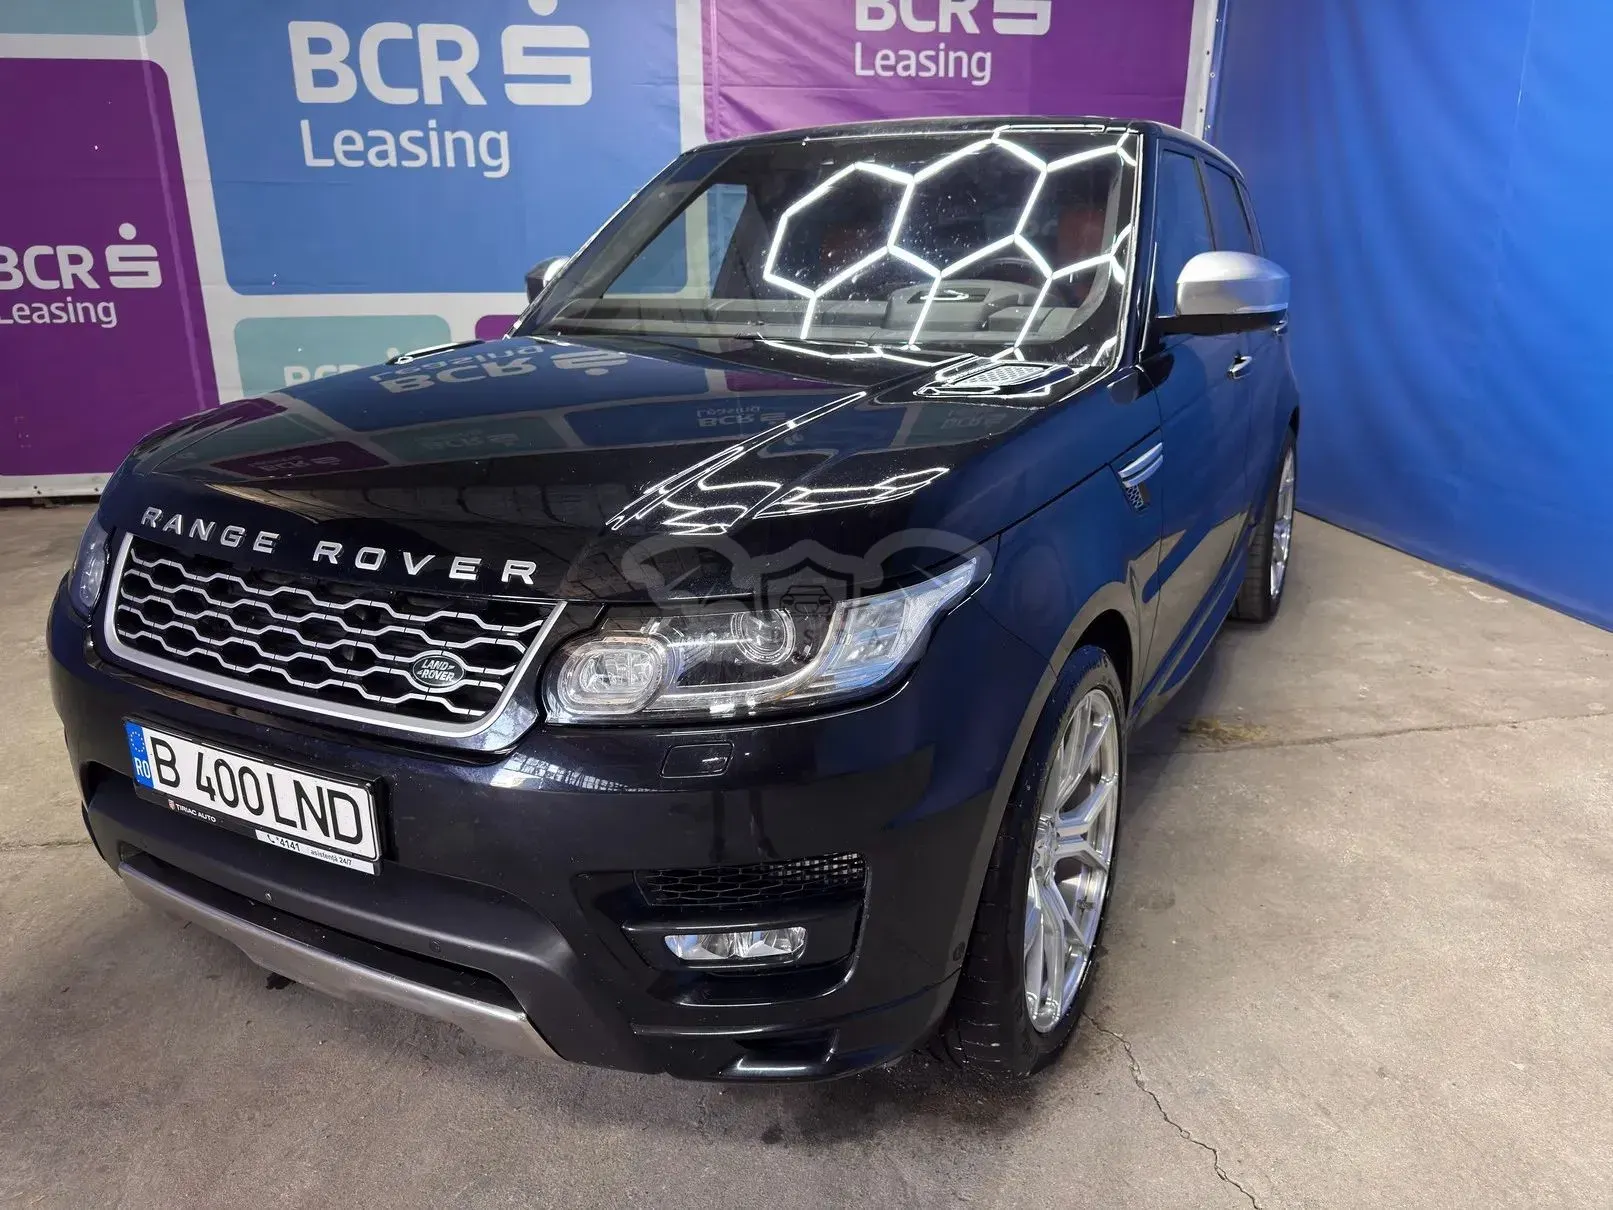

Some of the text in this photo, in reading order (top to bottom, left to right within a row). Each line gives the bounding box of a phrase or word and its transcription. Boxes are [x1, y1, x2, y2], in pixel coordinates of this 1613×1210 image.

[288, 20, 488, 105] BCR
[855, 42, 992, 86] Leasing
[300, 119, 511, 178] Leasing
[140, 506, 537, 585] RANGE ROVER
[420, 669, 455, 682] ROVER
[421, 659, 450, 671] LAND
[134, 757, 151, 779] RO
[150, 736, 181, 789] B
[197, 811, 217, 823] AUTO
